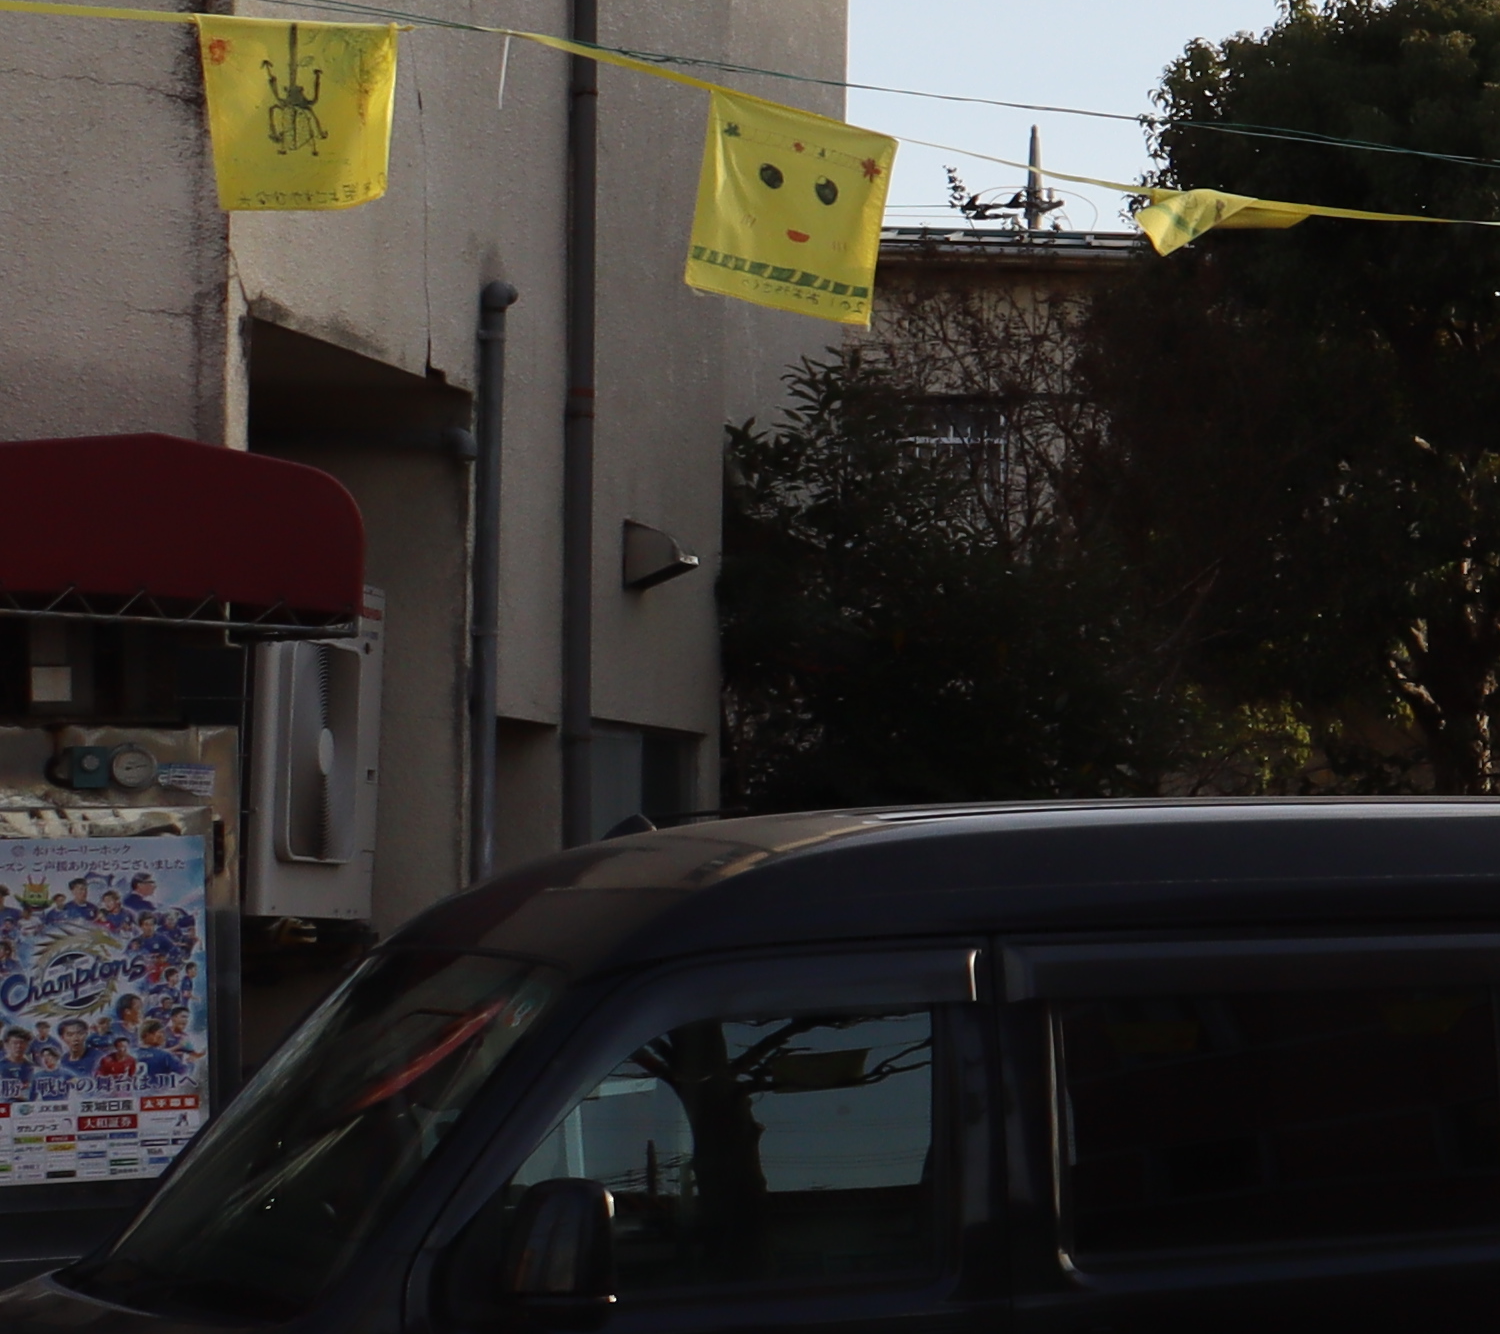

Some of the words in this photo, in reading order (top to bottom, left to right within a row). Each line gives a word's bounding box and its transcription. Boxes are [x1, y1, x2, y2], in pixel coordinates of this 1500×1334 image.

[1, 954, 147, 1012] Champions
[82, 1116, 133, 1130] 大和証券
